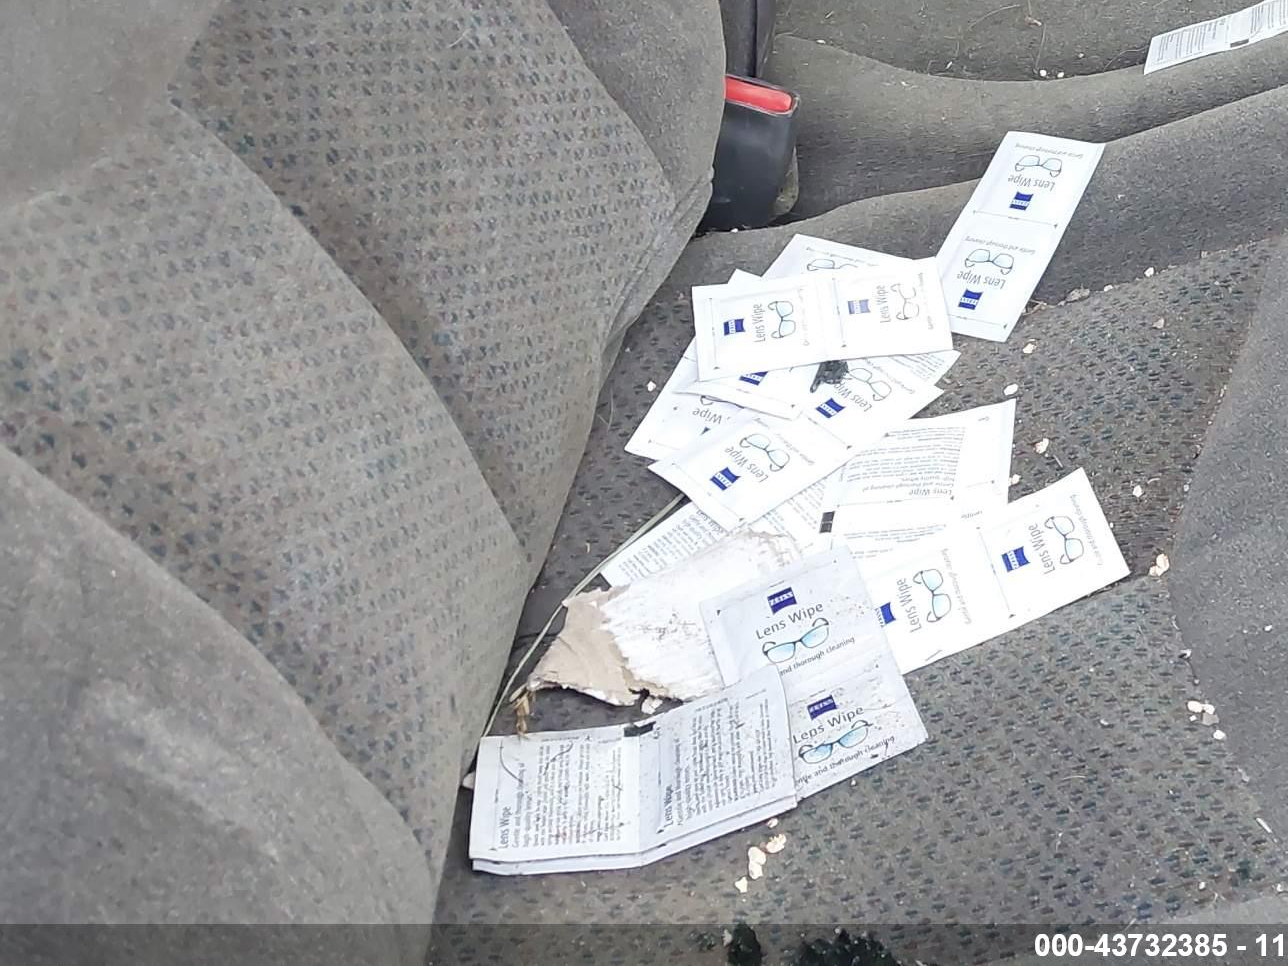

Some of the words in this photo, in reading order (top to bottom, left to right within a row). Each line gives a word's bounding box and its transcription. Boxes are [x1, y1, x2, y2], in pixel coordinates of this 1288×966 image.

[1007, 174, 1031, 187] Wipe
[1032, 181, 1055, 191] Lens
[956, 270, 982, 284] Wipe
[982, 275, 1006, 290] Lens
[752, 303, 764, 319] Wipe
[753, 319, 766, 343] Lens
[691, 407, 722, 425] Wipe
[723, 444, 748, 467] Wipe
[748, 465, 769, 483] Lens
[1028, 522, 1046, 551] Wipe
[1038, 550, 1055, 575] Lens
[768, 591, 794, 607] ZEISS
[896, 577, 912, 606] Wipe
[755, 617, 787, 640] Lens
[787, 602, 825, 624] Wipe
[904, 605, 922, 633] Lens
[792, 650, 826, 670] thorough
[826, 636, 856, 655] cleaning
[808, 698, 835, 714] ZEISS
[792, 722, 826, 744] Lens
[826, 707, 865, 728] Wipe
[500, 806, 512, 828] Wipe
[663, 805, 673, 828] Lens
[499, 829, 510, 849] Lens
